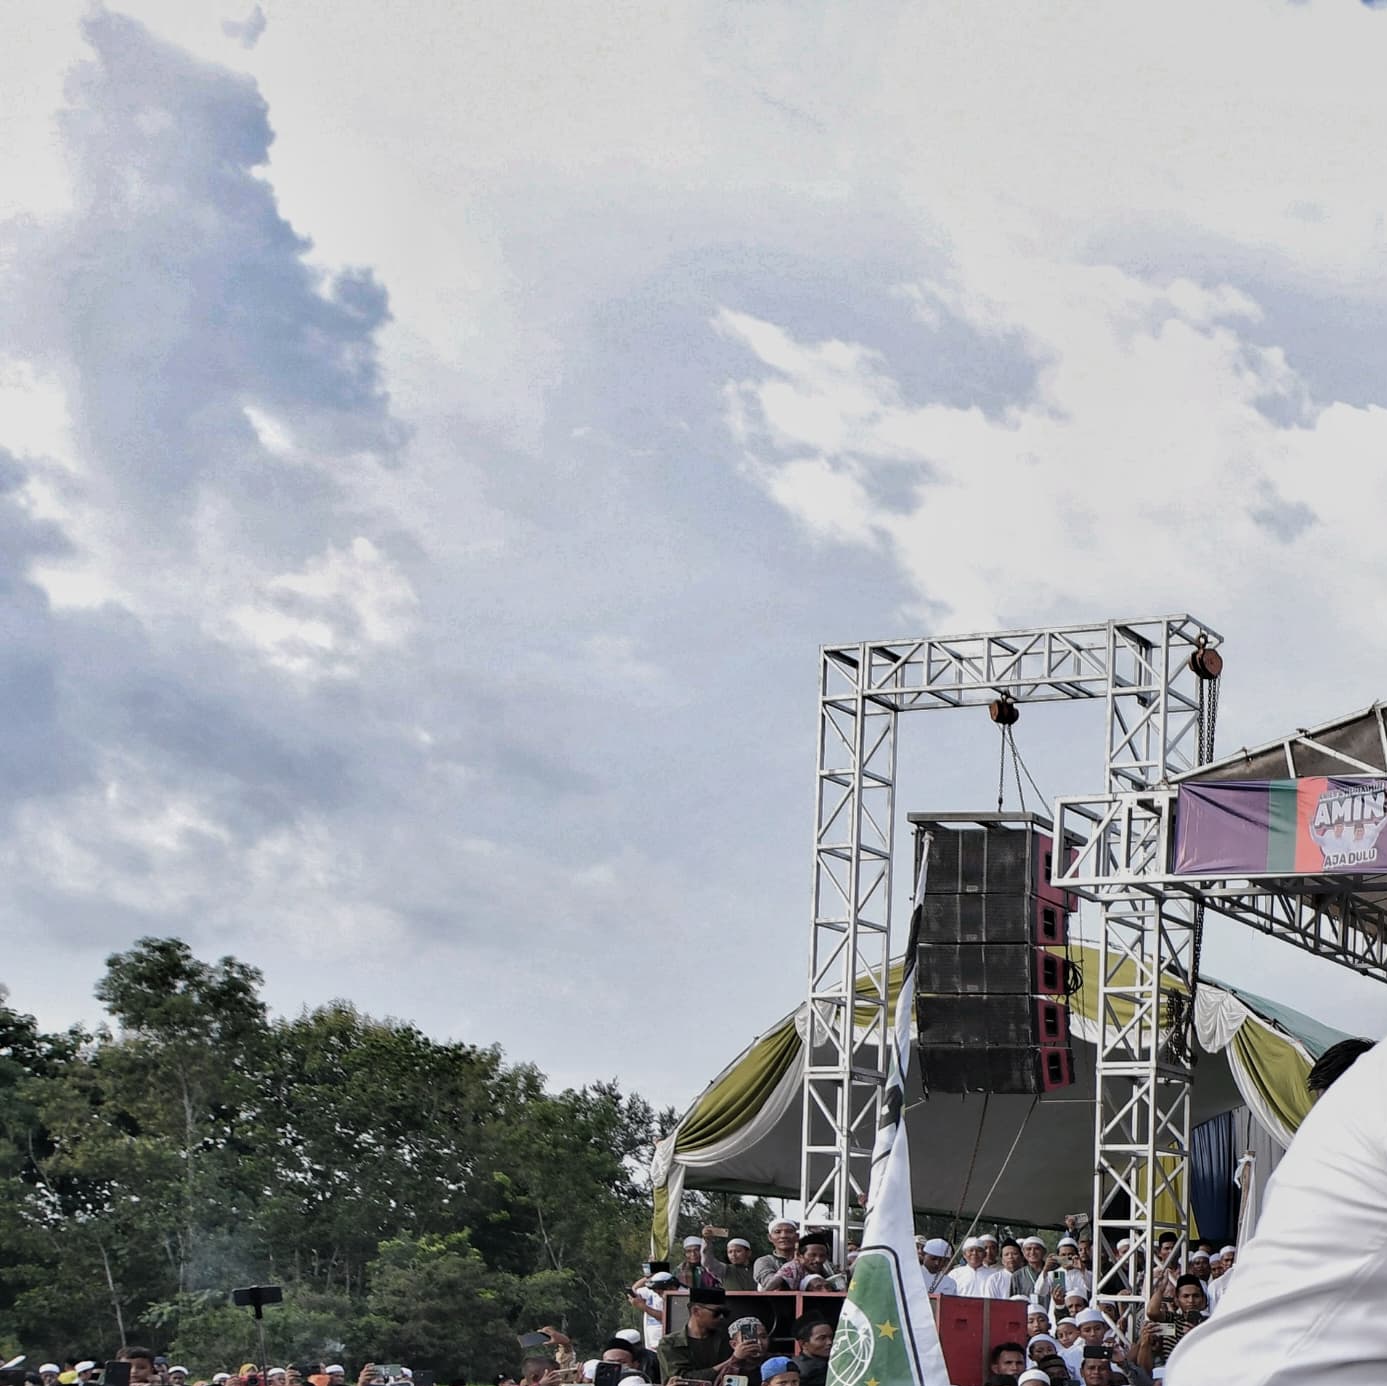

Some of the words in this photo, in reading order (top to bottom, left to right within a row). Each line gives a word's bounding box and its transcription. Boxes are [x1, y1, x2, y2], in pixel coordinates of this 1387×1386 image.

[1314, 791, 1386, 827] AMIN
[1324, 853, 1347, 868] AJA
[1348, 848, 1376, 865] DULU
